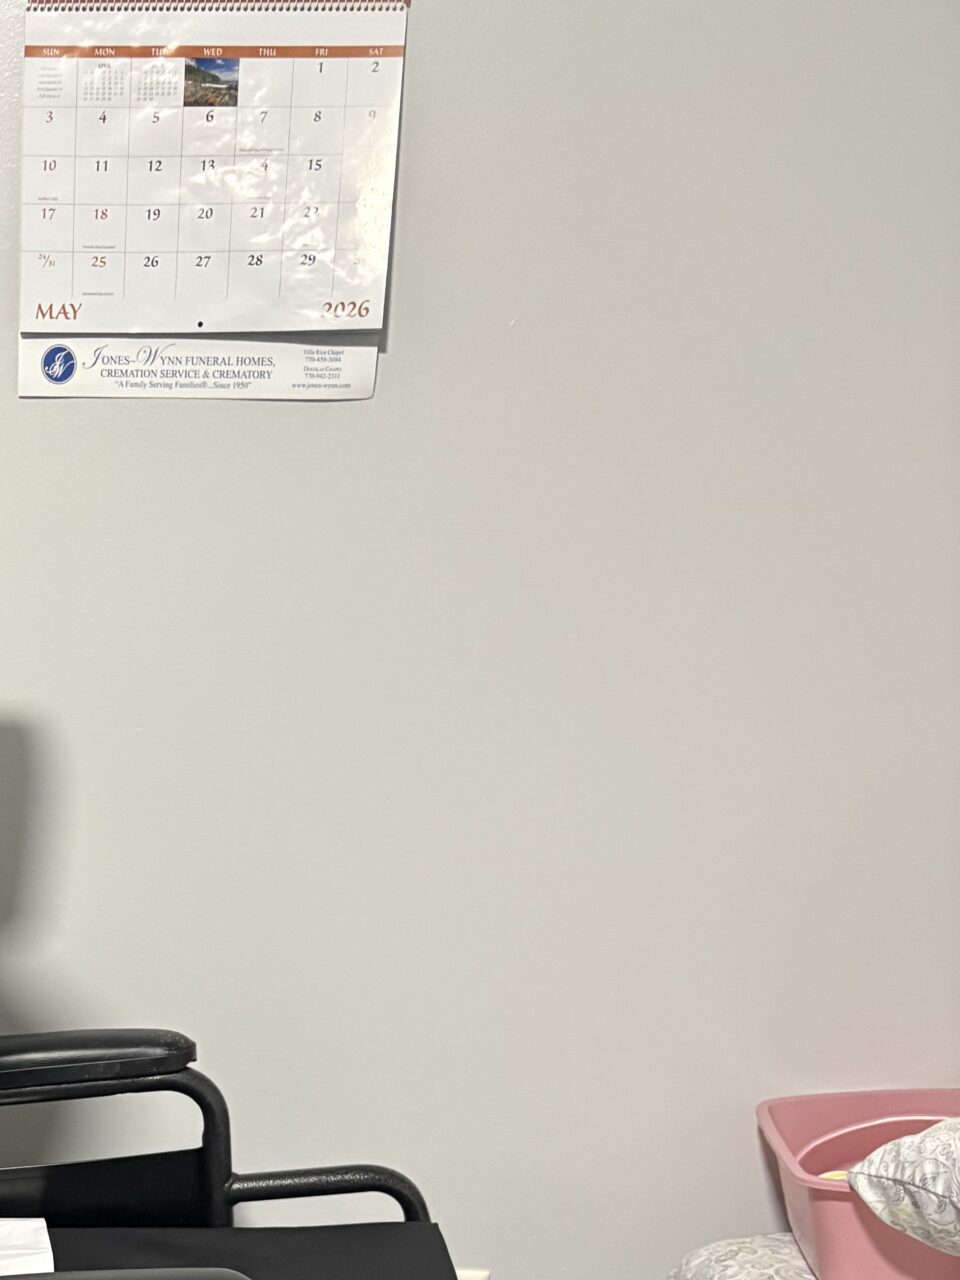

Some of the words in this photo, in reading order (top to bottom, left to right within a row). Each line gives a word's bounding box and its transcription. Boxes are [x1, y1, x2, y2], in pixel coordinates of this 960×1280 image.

[259, 48, 276, 56] THU
[371, 61, 379, 72] 2
[45, 111, 53, 123] 3
[98, 111, 106, 123] 4
[152, 112, 159, 123] 5
[205, 111, 213, 122] 6
[259, 111, 268, 123] 7
[313, 111, 321, 122] 8
[43, 160, 56, 171] 10
[95, 161, 107, 171] 11
[149, 161, 161, 171] 12
[201, 160, 214, 171] 13
[308, 159, 321, 171] 15
[42, 208, 55, 220] 17
[95, 209, 107, 219] 18
[147, 209, 160, 220] 19
[197, 208, 213, 219] 20
[250, 207, 264, 218] 21
[91, 256, 106, 267] 25
[143, 256, 158, 267] 26
[195, 256, 211, 267] 27
[247, 255, 263, 265] 28
[300, 254, 316, 265] 29
[35, 304, 81, 320] MAY
[321, 300, 369, 317] 2026
[185, 356, 233, 366] FUNERAL
[236, 356, 276, 367] HOMES,
[100, 369, 157, 378] CREMATION
[160, 369, 200, 378] SERVICE
[202, 370, 210, 378] &
[212, 370, 273, 379] CREMATORY
[125, 381, 147, 390] Family
[148, 381, 173, 390] Serving
